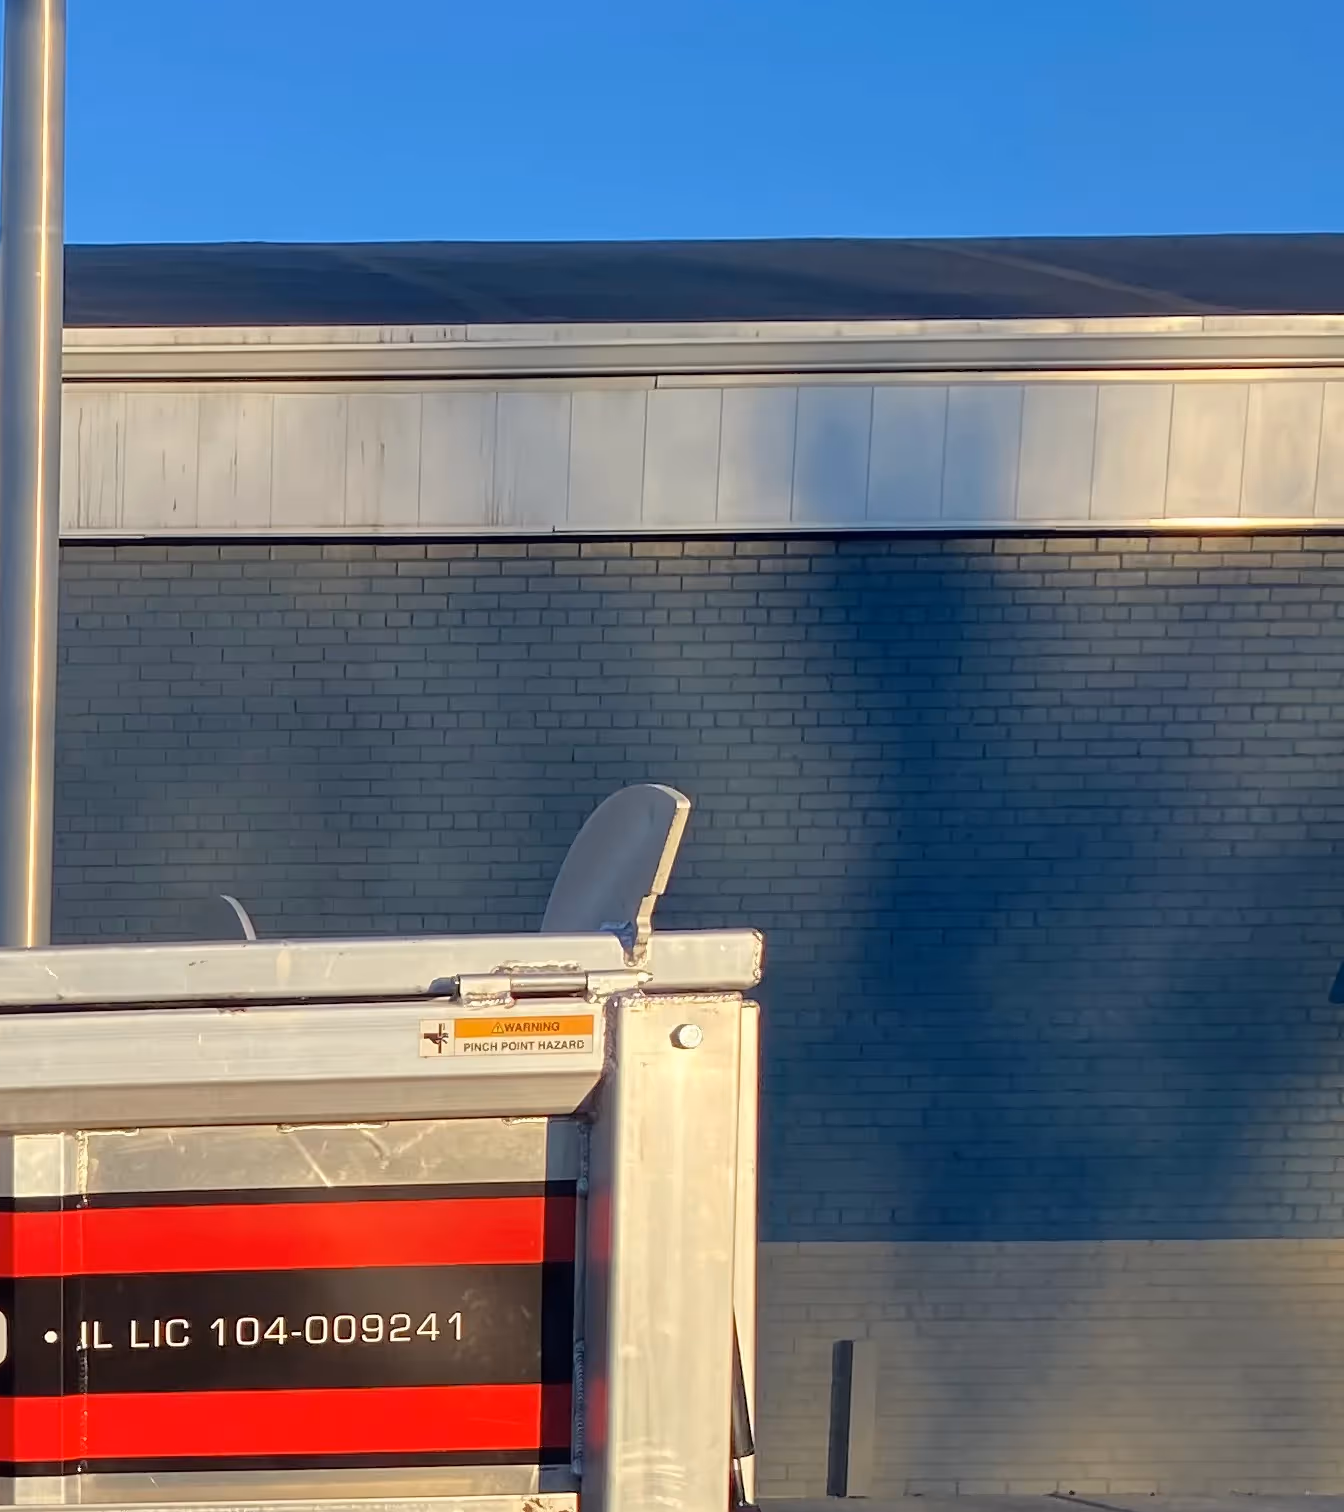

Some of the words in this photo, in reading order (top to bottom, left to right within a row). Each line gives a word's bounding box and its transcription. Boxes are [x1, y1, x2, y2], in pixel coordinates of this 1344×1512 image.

[504, 1022, 561, 1033] WARNING
[463, 1042, 499, 1053] PINCH
[501, 1041, 535, 1051] POINT
[537, 1039, 585, 1050] HAZARD
[80, 1320, 114, 1350] IL
[130, 1318, 191, 1349] LIC
[210, 1312, 464, 1348] 104-009241
